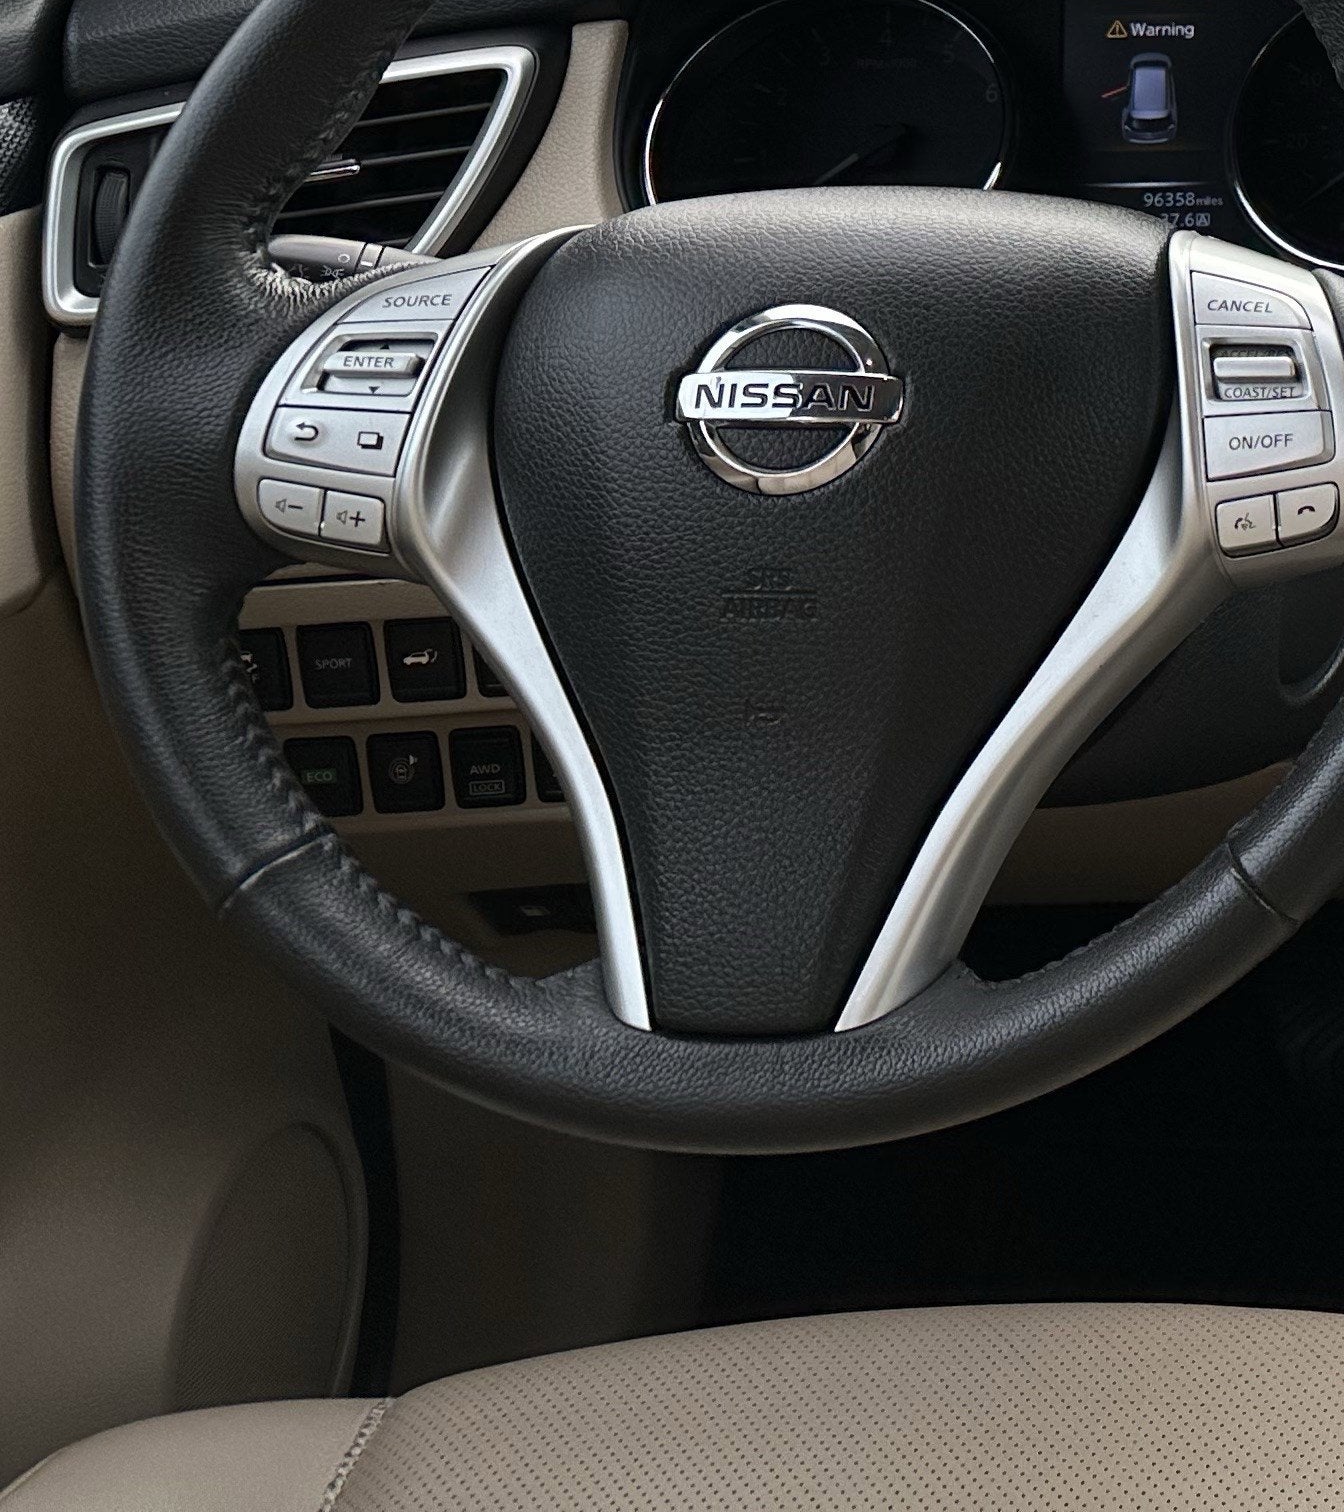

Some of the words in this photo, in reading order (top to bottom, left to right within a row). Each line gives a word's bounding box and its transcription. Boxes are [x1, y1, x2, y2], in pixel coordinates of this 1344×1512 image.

[1130, 22, 1195, 39] Warning
[1143, 192, 1196, 207] 96358
[1196, 196, 1224, 206] miles
[382, 293, 453, 308] SOURCE
[1207, 298, 1273, 314] CANCEL
[342, 355, 394, 369] ENTER
[694, 383, 875, 412] NISSAN
[1224, 386, 1297, 400] COAST/SET
[1228, 433, 1294, 451] ON/OFF
[314, 657, 353, 671] SPORT
[469, 763, 501, 775] AWD
[304, 770, 334, 784] ECO
[470, 782, 502, 794] LOCK
